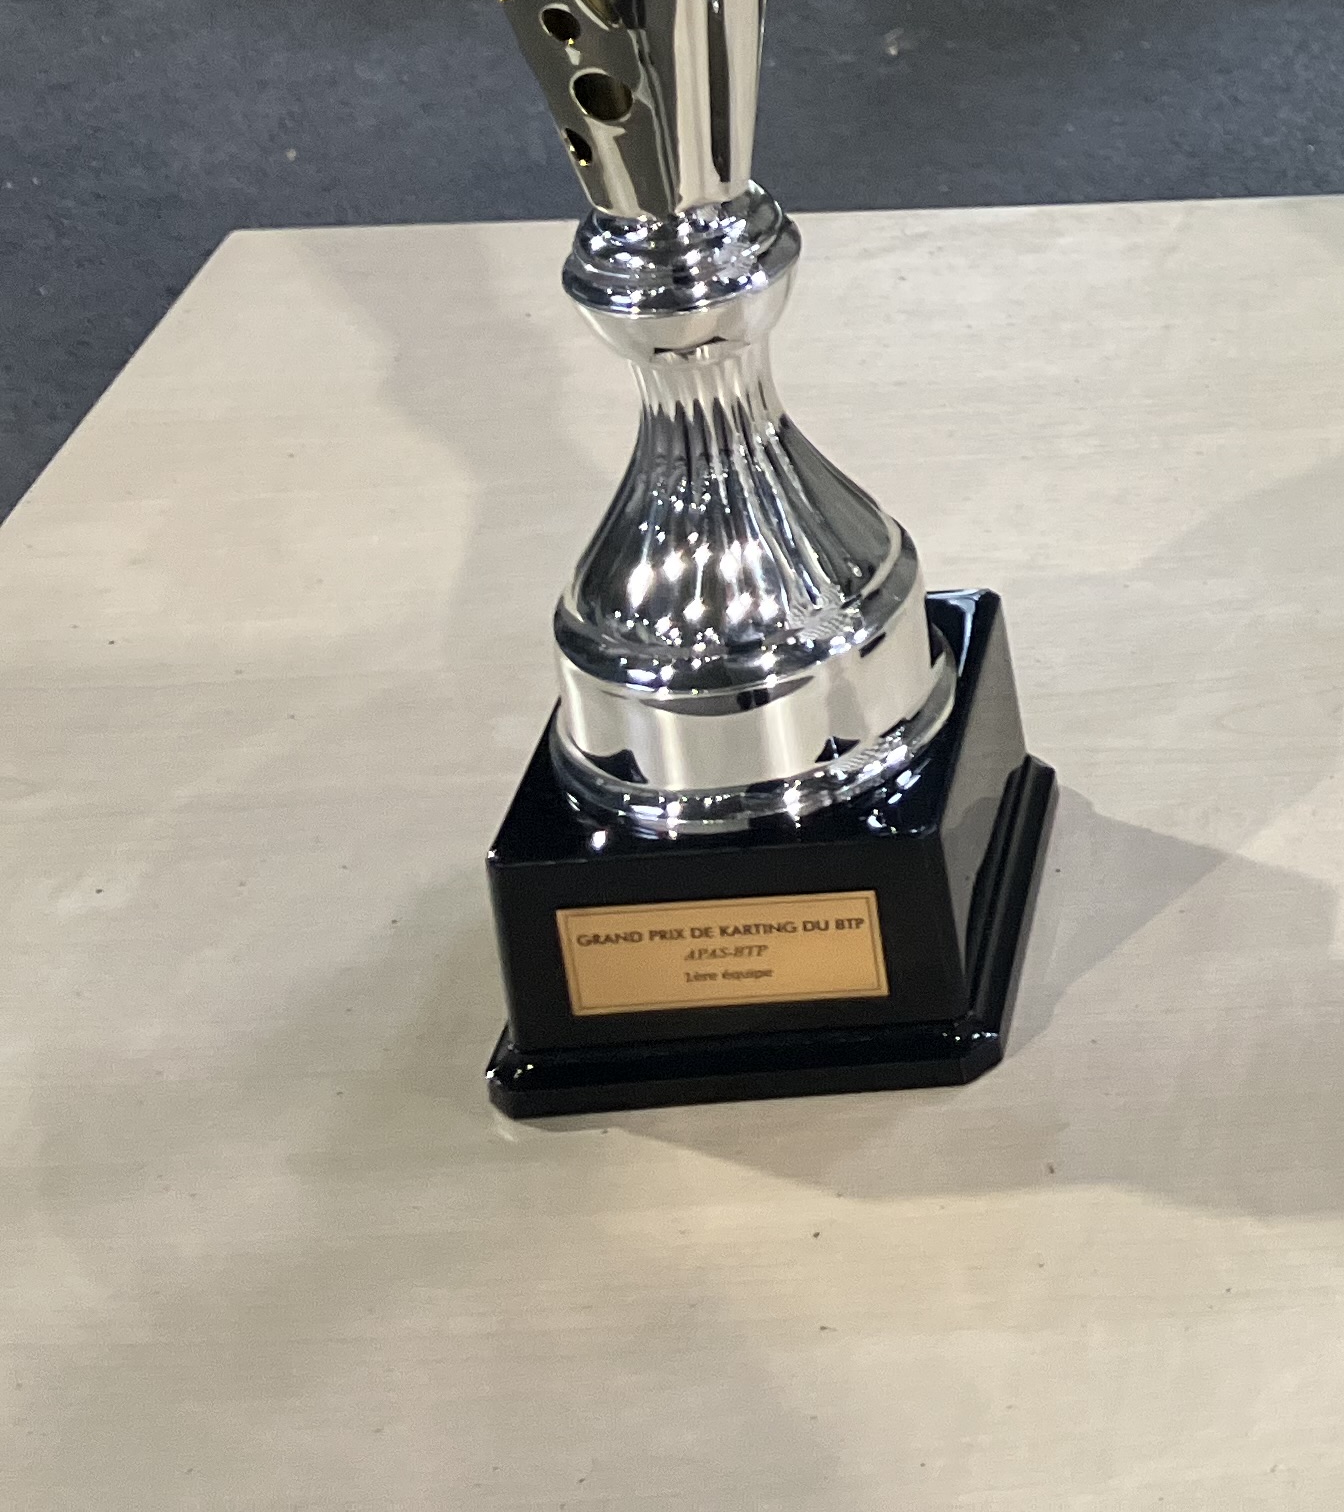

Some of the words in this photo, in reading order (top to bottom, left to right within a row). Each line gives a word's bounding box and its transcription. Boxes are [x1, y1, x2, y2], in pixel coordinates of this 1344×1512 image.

[577, 931, 643, 947] GRAND
[648, 927, 687, 942] PRIX
[690, 926, 715, 940] DE
[719, 920, 798, 937] KARTING
[802, 919, 830, 932] DU
[834, 917, 865, 930] BTP
[684, 944, 769, 962] APAS-BTP
[721, 967, 774, 981] équipe
